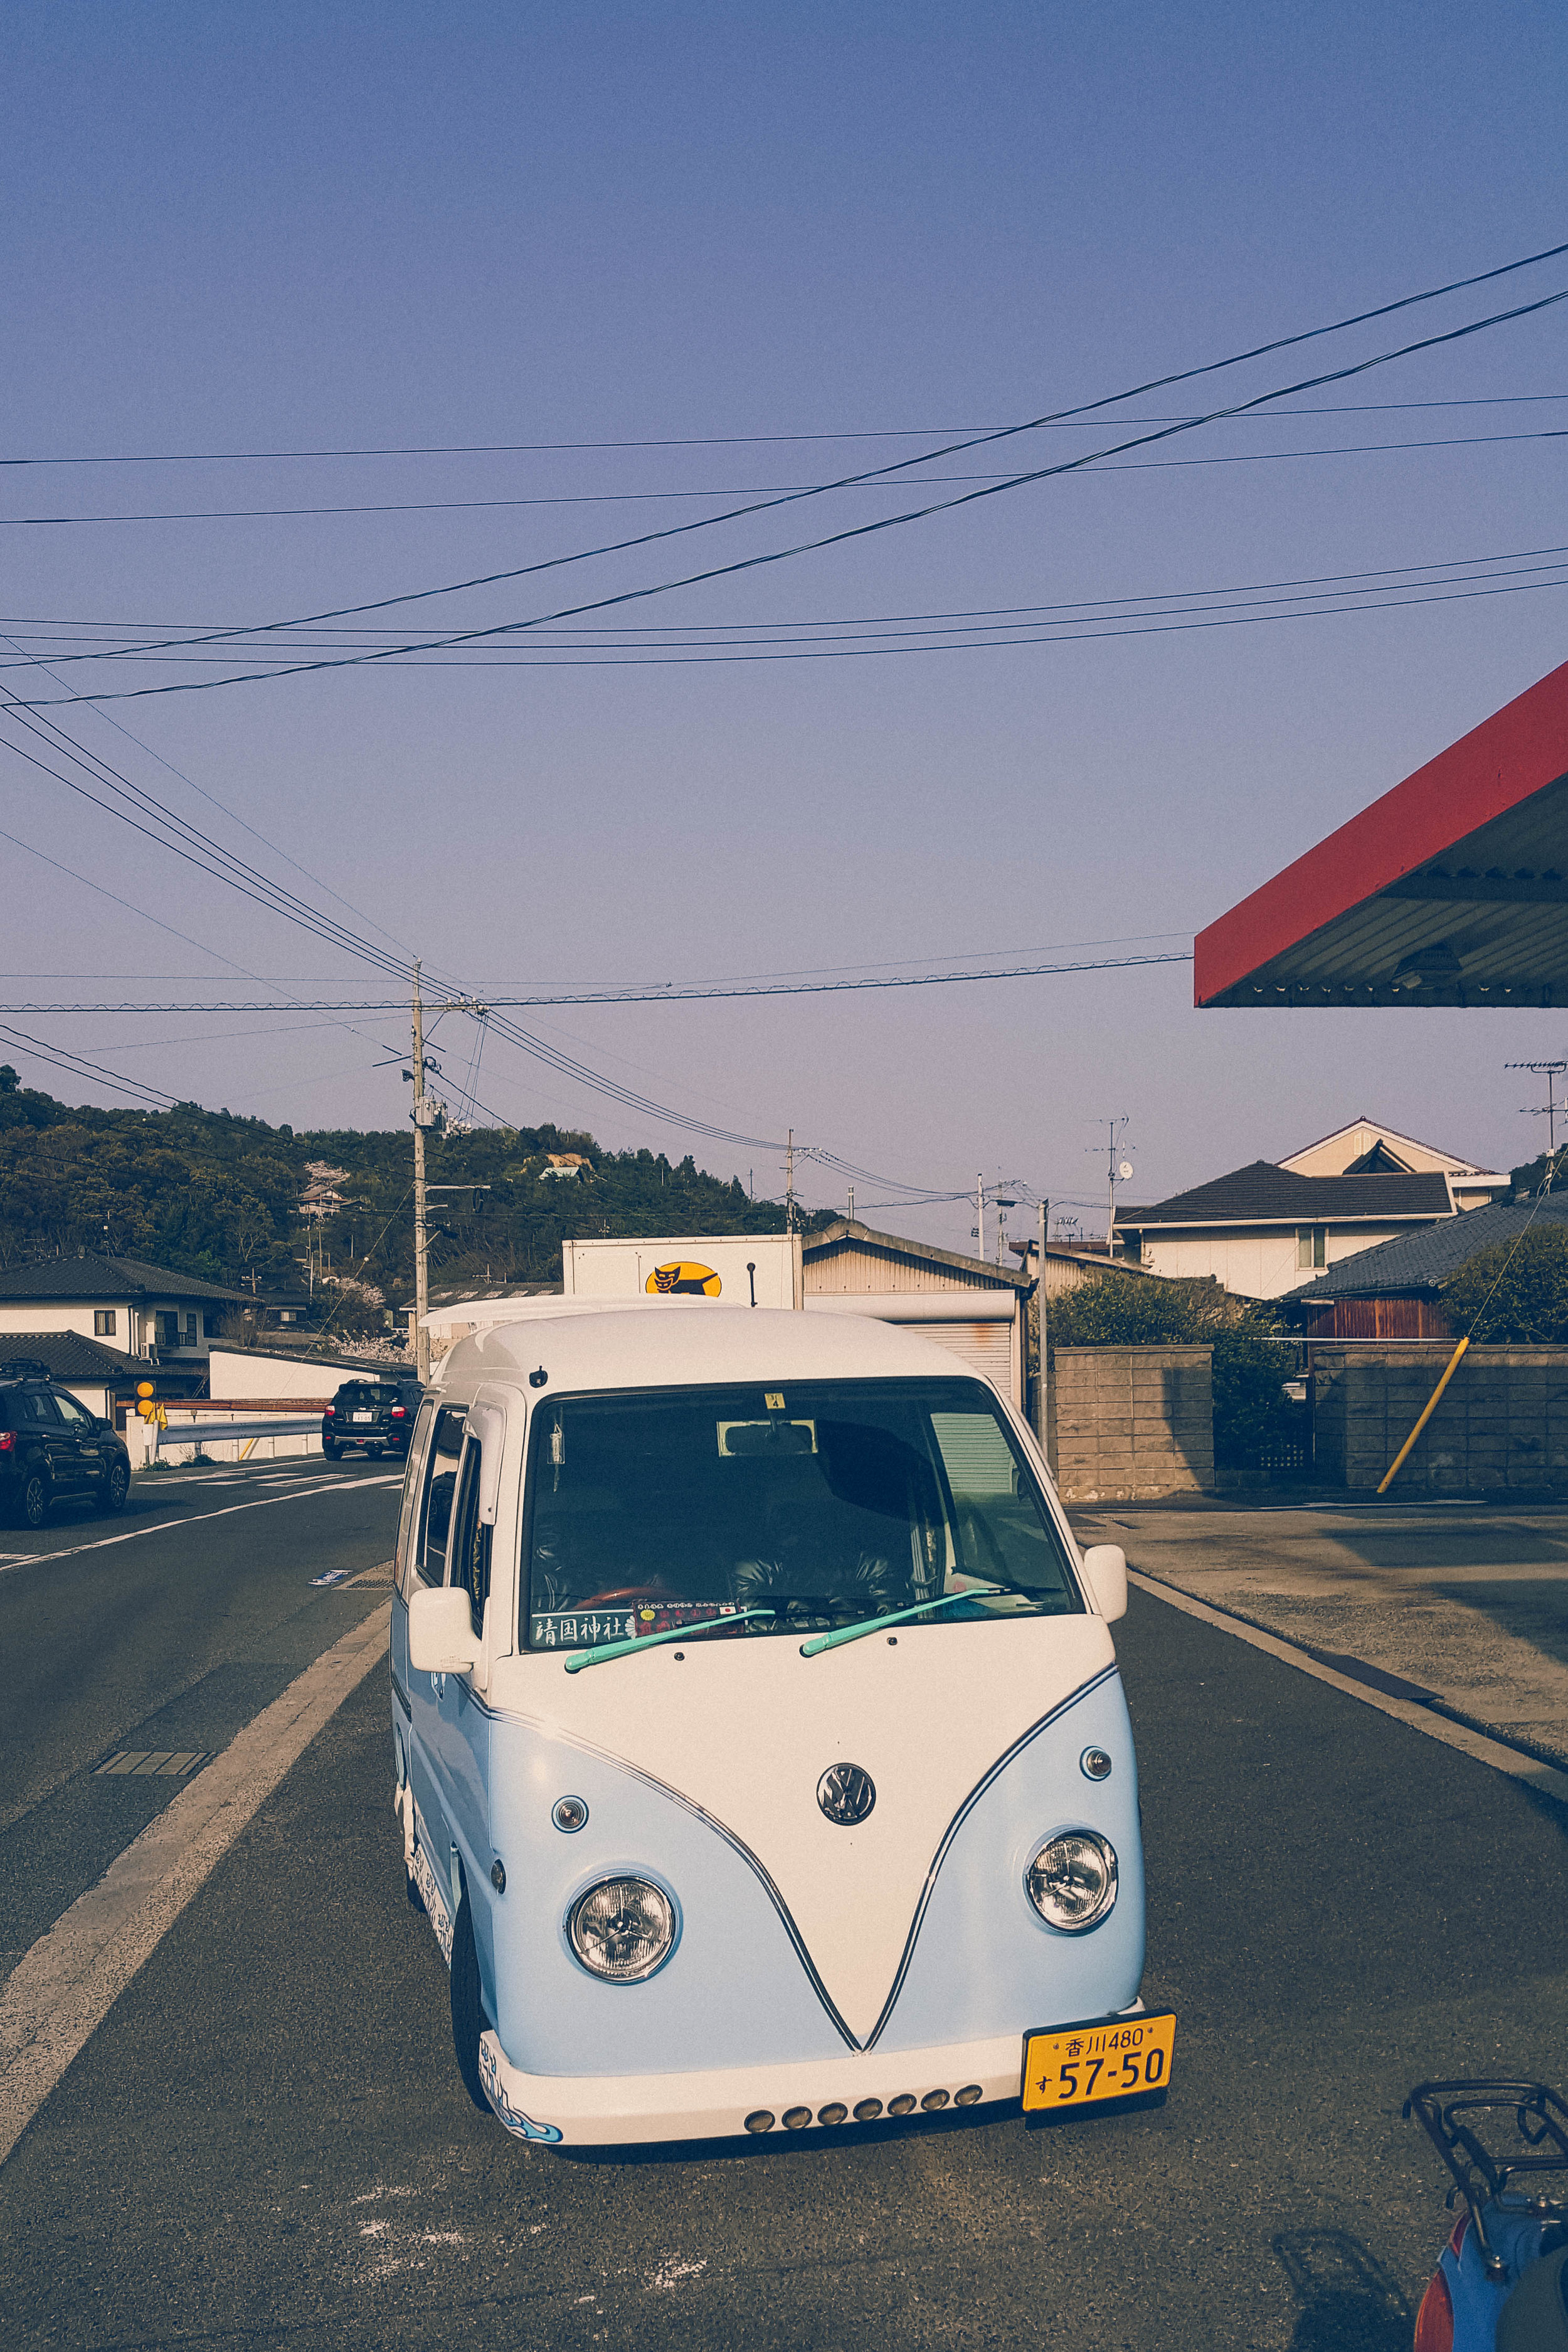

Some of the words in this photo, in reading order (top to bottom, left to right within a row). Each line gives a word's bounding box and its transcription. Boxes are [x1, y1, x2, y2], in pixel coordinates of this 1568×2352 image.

[535, 1615, 625, 1646] 靖国神社
[821, 1767, 872, 1820] VW
[1065, 2028, 1144, 2057] 香川480
[1036, 2075, 1052, 2095] す
[1058, 2048, 1165, 2099] 57-50
